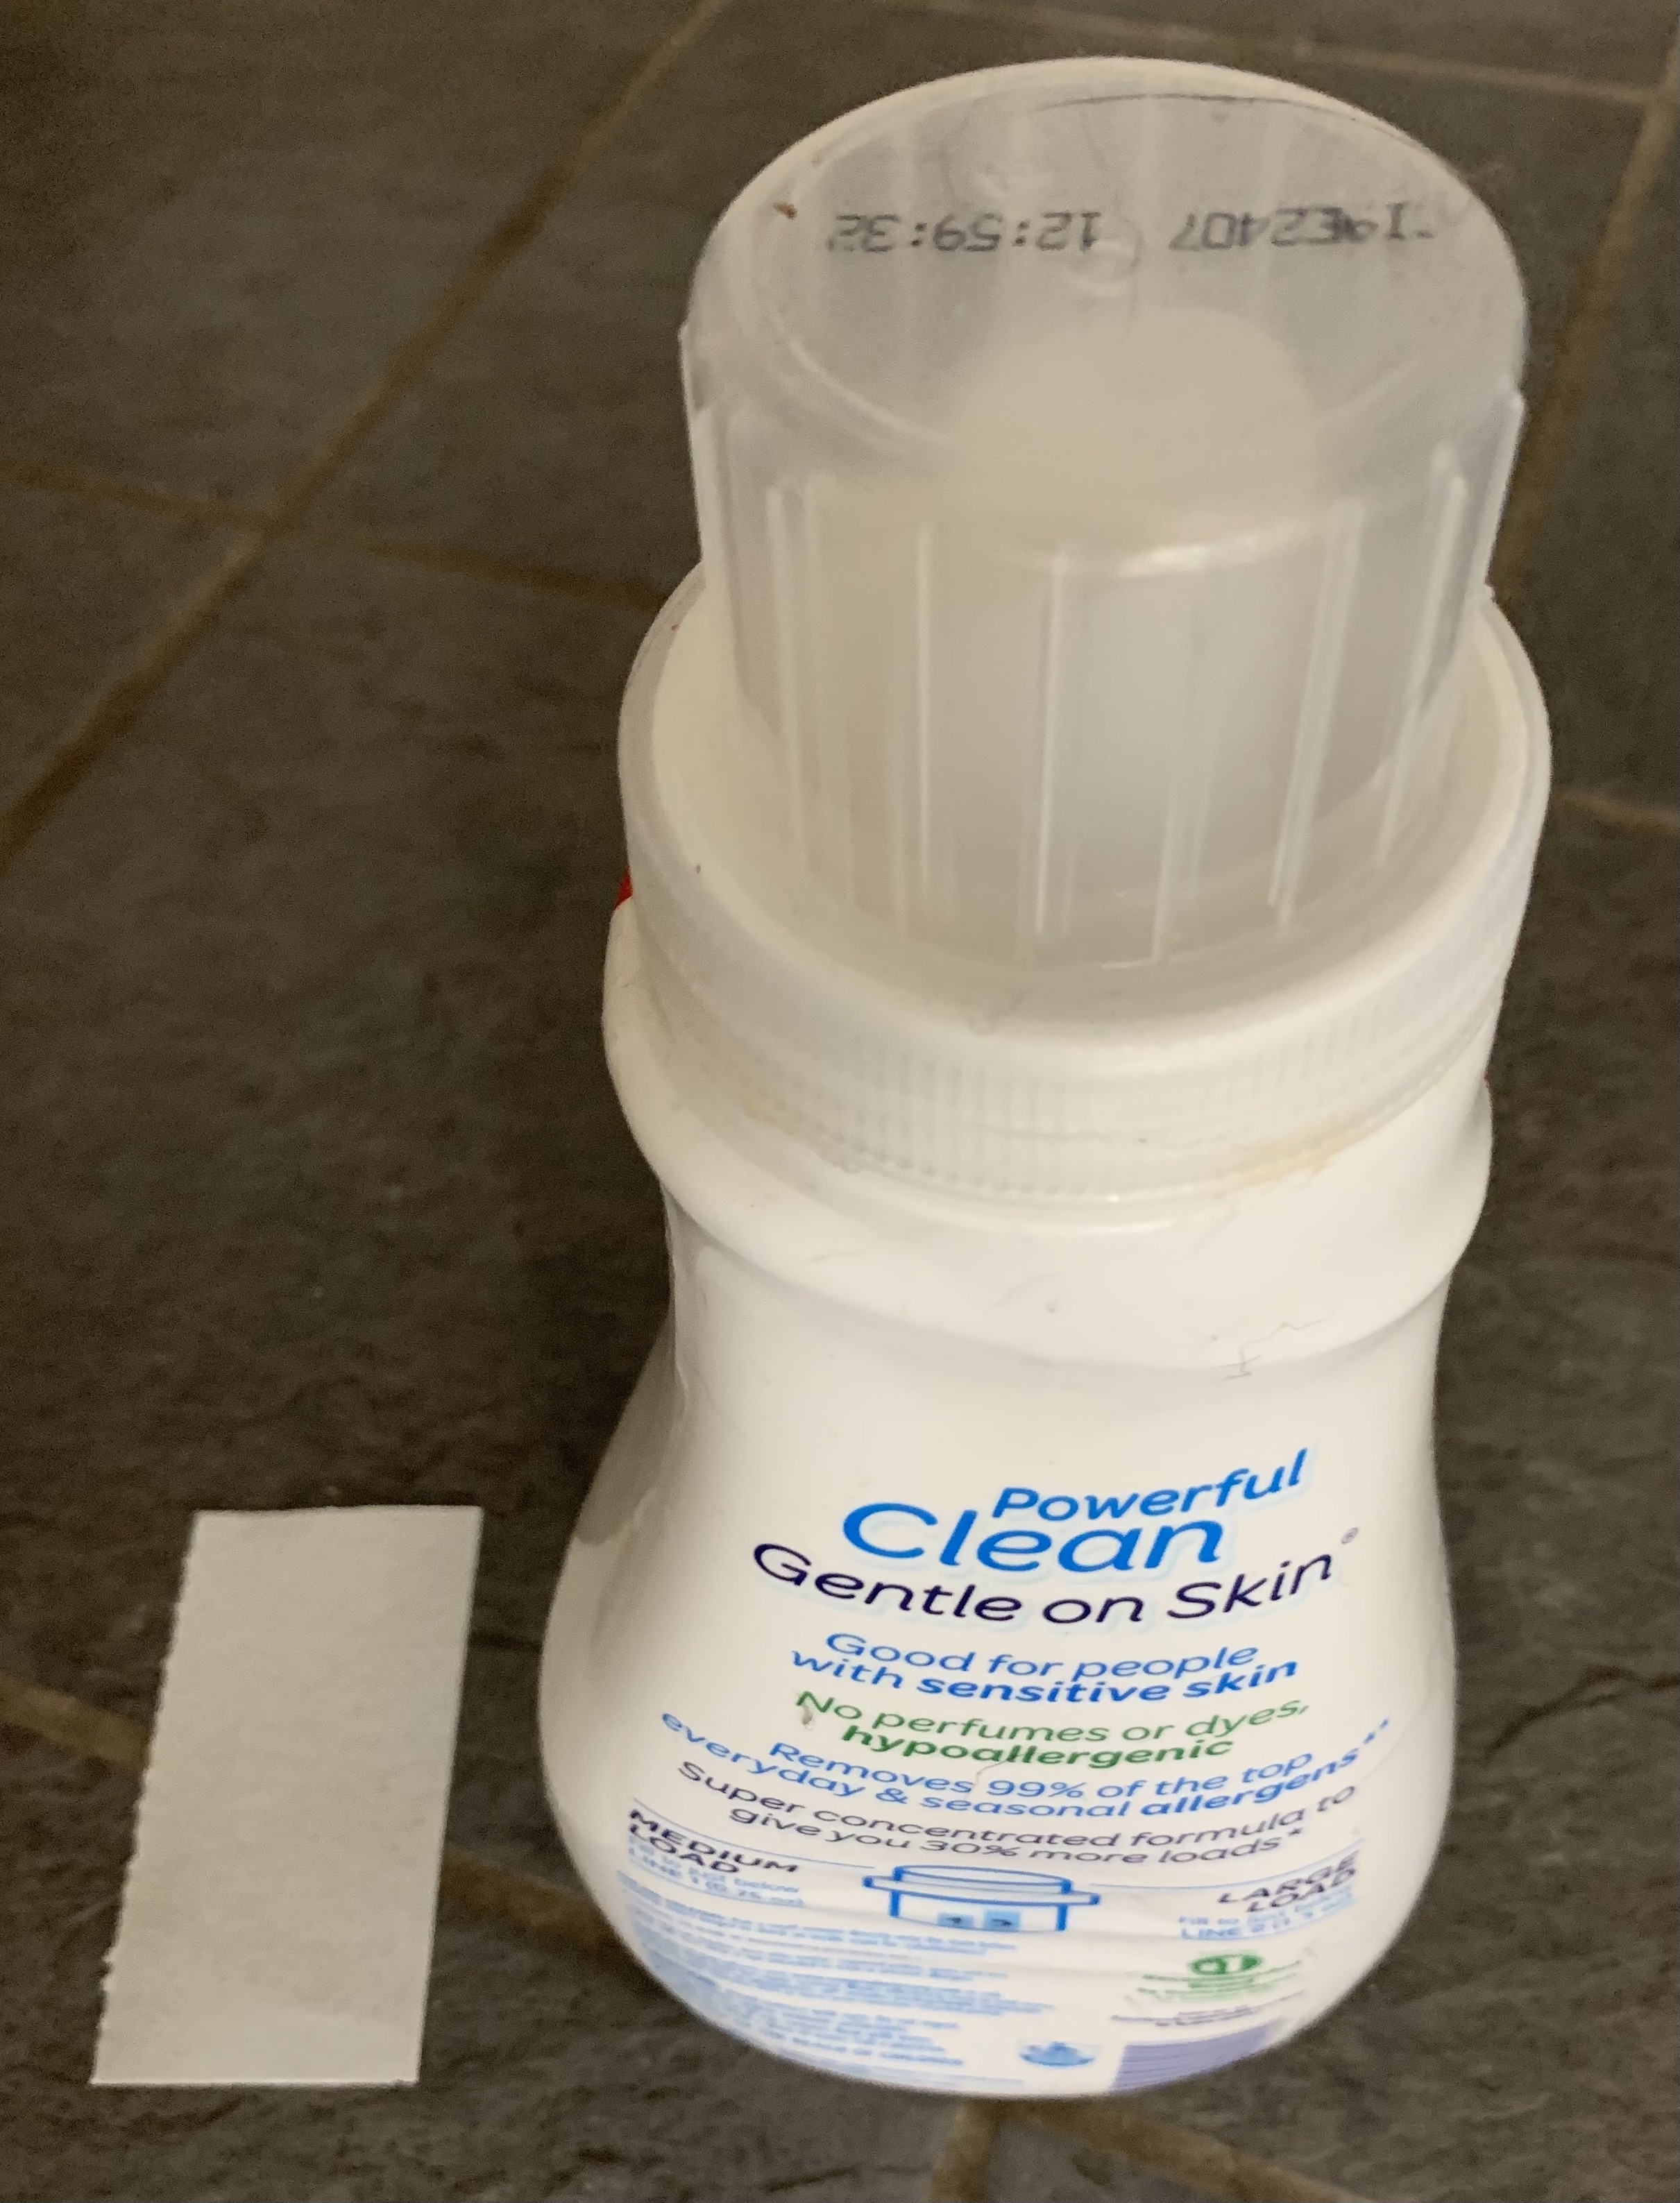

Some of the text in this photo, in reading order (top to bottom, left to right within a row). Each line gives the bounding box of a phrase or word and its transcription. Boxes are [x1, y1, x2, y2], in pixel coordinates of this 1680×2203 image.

[992, 1448, 1308, 1522] Powerful
[842, 1502, 1223, 1573] Clean
[754, 1543, 1333, 1624] Gentle on Skin
[792, 1650, 1298, 1703] with sensitive skin
[826, 1632, 1259, 1683] Good for people
[795, 1690, 1309, 1742] No perfumes or dyes,
[661, 1712, 866, 1797] everyday
[874, 1787, 910, 1805] &
[920, 1794, 1132, 1817] seasonal
[768, 1742, 1314, 1798] Removes 99% of the top
[841, 1725, 1233, 1769] hypoallergenic
[678, 1760, 1356, 1847] Super concentrated formula to
[628, 1808, 799, 1872] MEDIUM
[629, 1824, 741, 1874] LOAD
[729, 1807, 823, 1837] give
[824, 1828, 912, 1851] you
[919, 1839, 1019, 1859] 30%
[1028, 1848, 1148, 1865] more
[1217, 1850, 1359, 1904] LARGE
